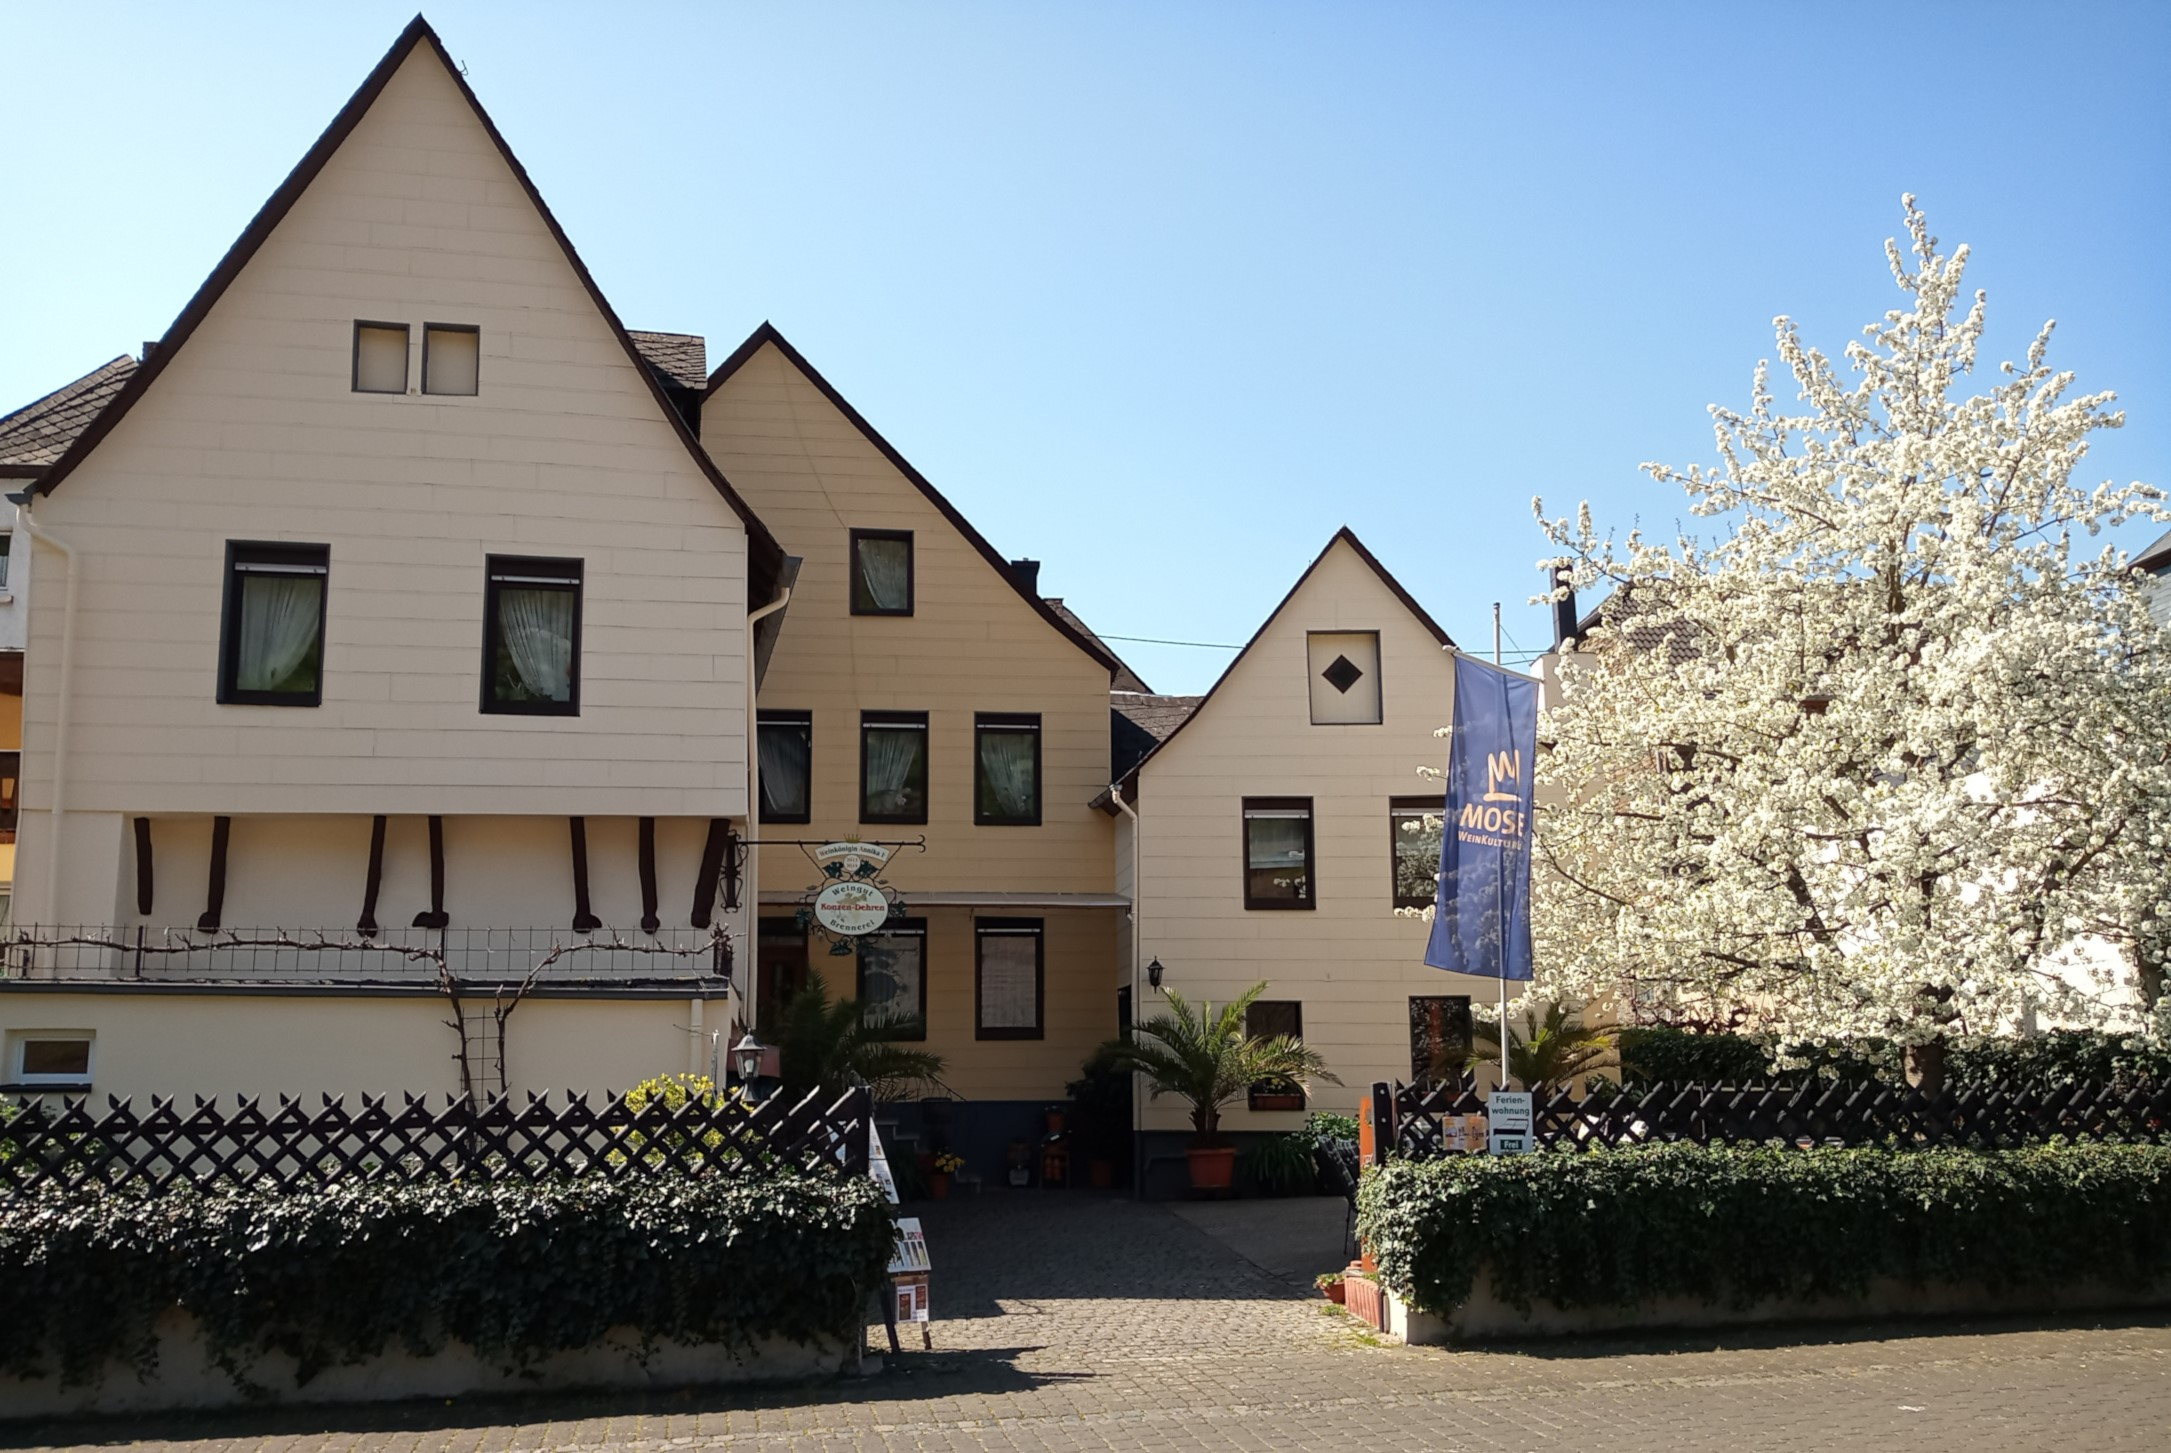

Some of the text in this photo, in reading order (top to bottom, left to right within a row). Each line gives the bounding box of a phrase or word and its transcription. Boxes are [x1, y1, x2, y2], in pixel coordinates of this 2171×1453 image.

[1460, 803, 1525, 837] MOSE
[860, 846, 881, 856] Annika
[832, 885, 874, 897] Weingut
[821, 903, 885, 912] Konzen-Dehren
[830, 919, 875, 931] Brennerei
[1495, 1096, 1525, 1104] Ferien-
[1492, 1107, 1530, 1116] wohnung
[1503, 1140, 1519, 1149] Frei
